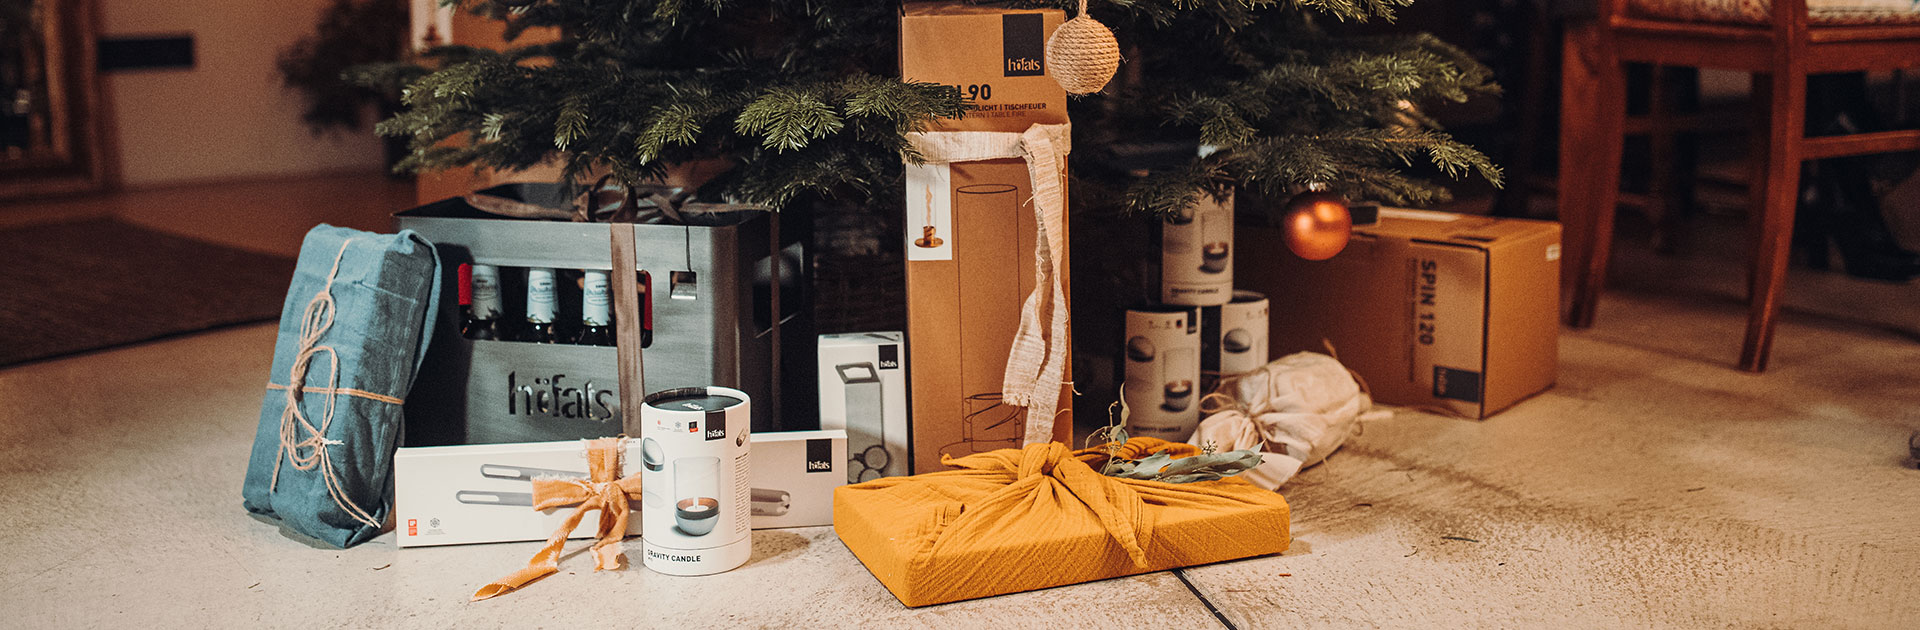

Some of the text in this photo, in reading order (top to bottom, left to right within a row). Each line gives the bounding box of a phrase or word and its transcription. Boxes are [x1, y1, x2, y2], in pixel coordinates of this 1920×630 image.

[1007, 57, 1041, 71] höfats
[968, 84, 991, 100] 90
[1004, 103, 1047, 111] TISCHFEUER
[1419, 260, 1436, 345] SPIN 120
[508, 371, 613, 421] höfats
[647, 549, 701, 563] GRAVITY CANDLE
